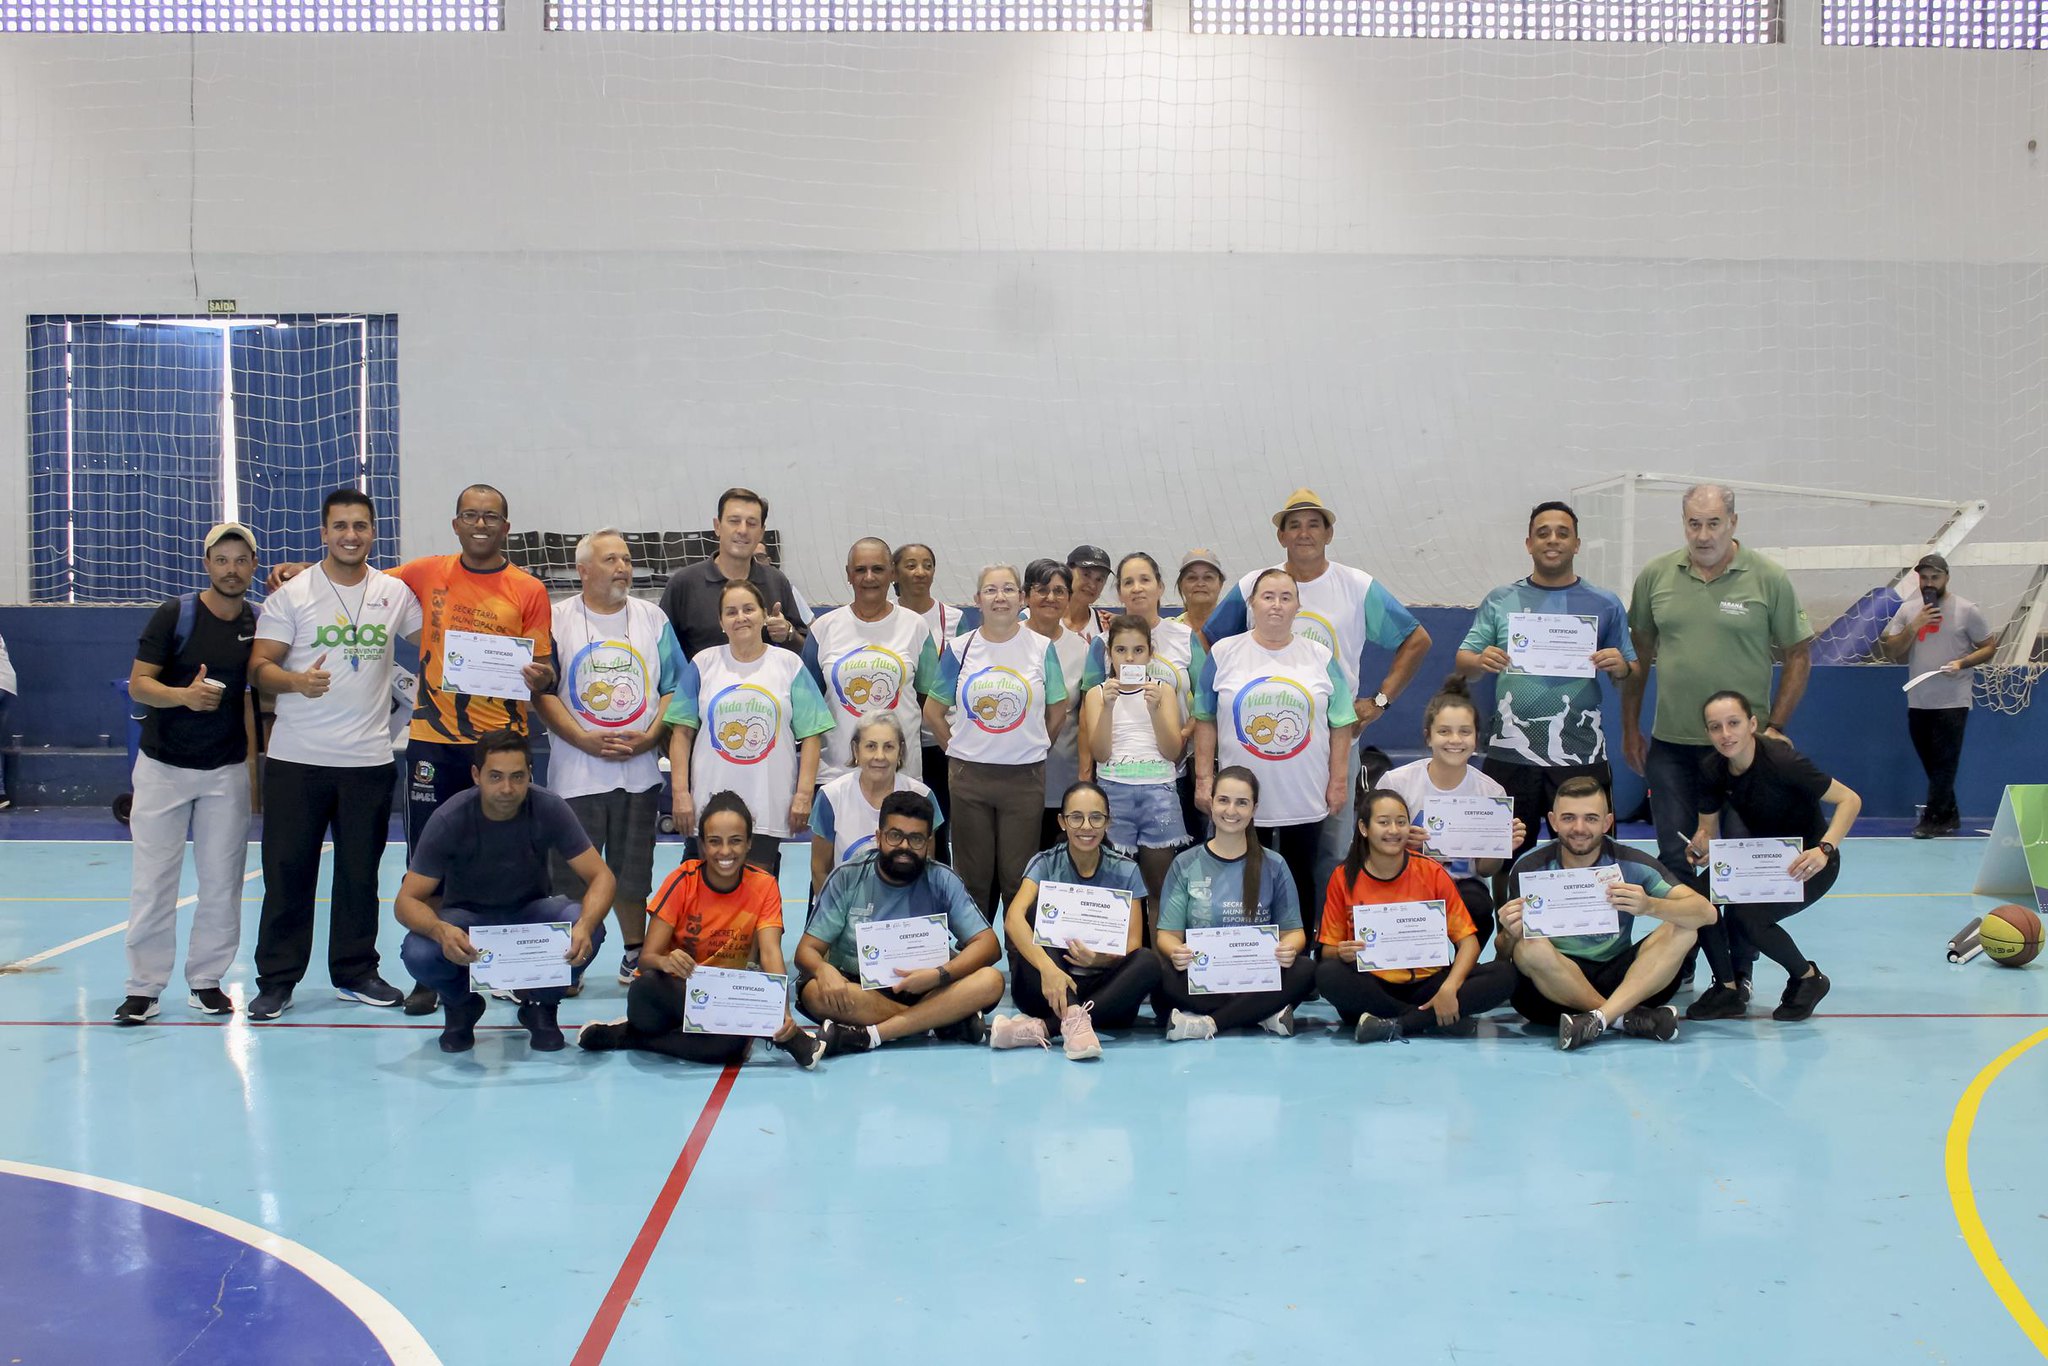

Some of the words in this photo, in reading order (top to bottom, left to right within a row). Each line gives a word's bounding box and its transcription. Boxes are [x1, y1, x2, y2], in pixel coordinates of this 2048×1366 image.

[453, 604, 498, 621] SECRETARIA
[451, 615, 494, 632] MUNICIPAL
[310, 624, 388, 648] JOGOS
[484, 649, 513, 657] CERTIFICADO
[841, 660, 867, 671] Vida
[869, 656, 899, 674] Ativa
[971, 679, 994, 691] Vida
[995, 677, 1023, 692] Ativa
[717, 701, 742, 716] Vida
[744, 698, 774, 718] Ativa
[1244, 692, 1273, 709] Vida
[1274, 690, 1305, 711] Ativa
[1080, 901, 1111, 909] CERTIFICADO
